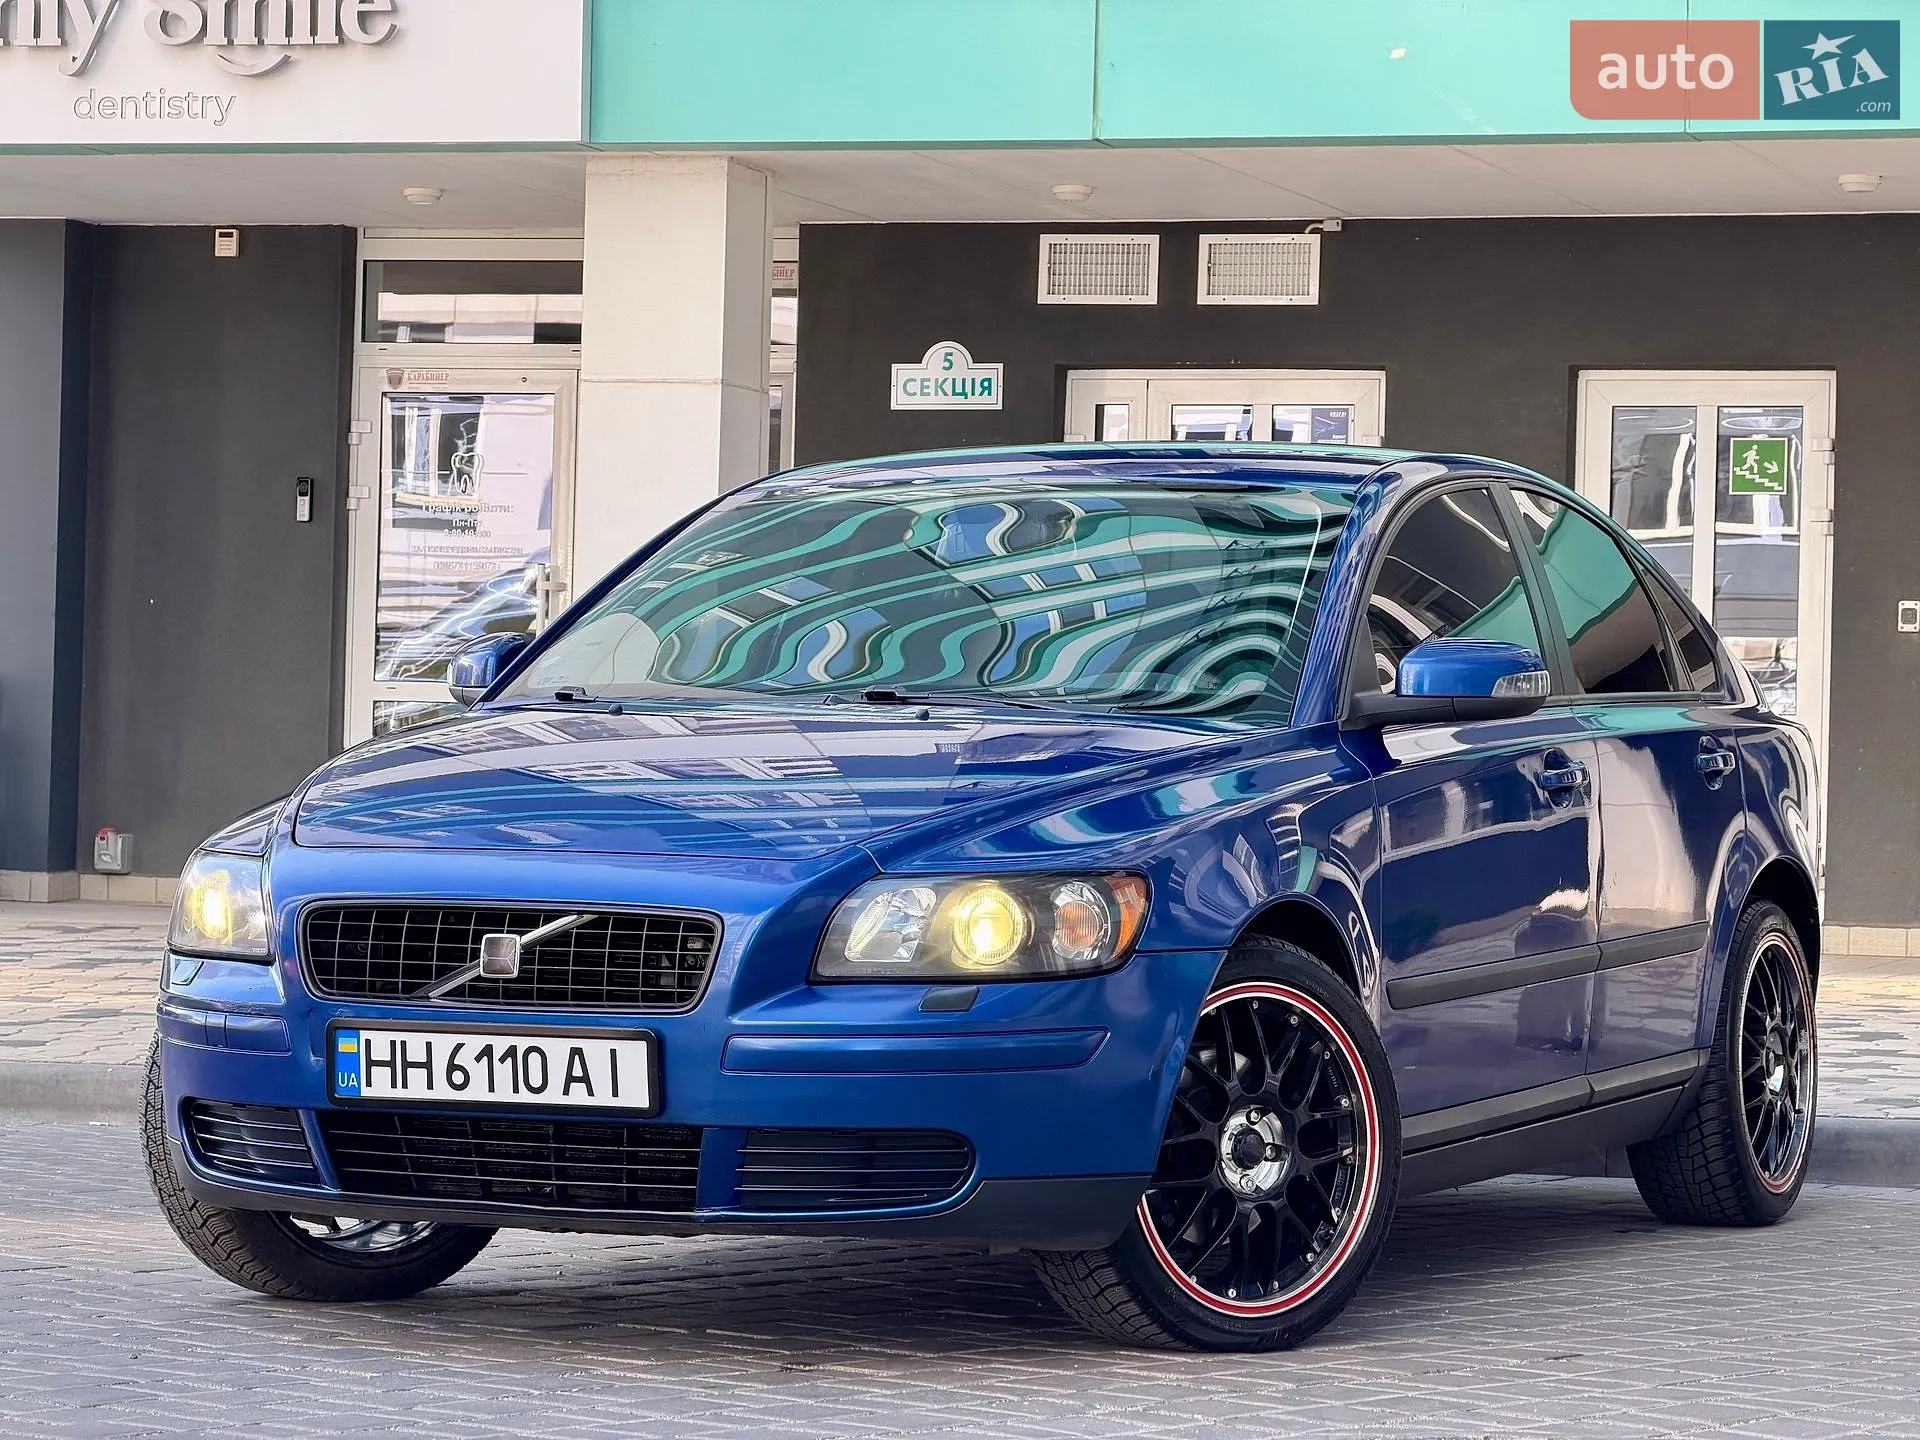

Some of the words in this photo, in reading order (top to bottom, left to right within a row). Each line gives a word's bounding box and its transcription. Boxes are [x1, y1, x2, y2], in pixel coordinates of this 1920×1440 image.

[73, 88, 236, 126] dentistry
[942, 352, 953, 371] 5
[902, 377, 993, 399] СЕКЦІЯ
[338, 1072, 358, 1088] UA
[364, 1038, 434, 1090] HH
[445, 1042, 549, 1095] 6110
